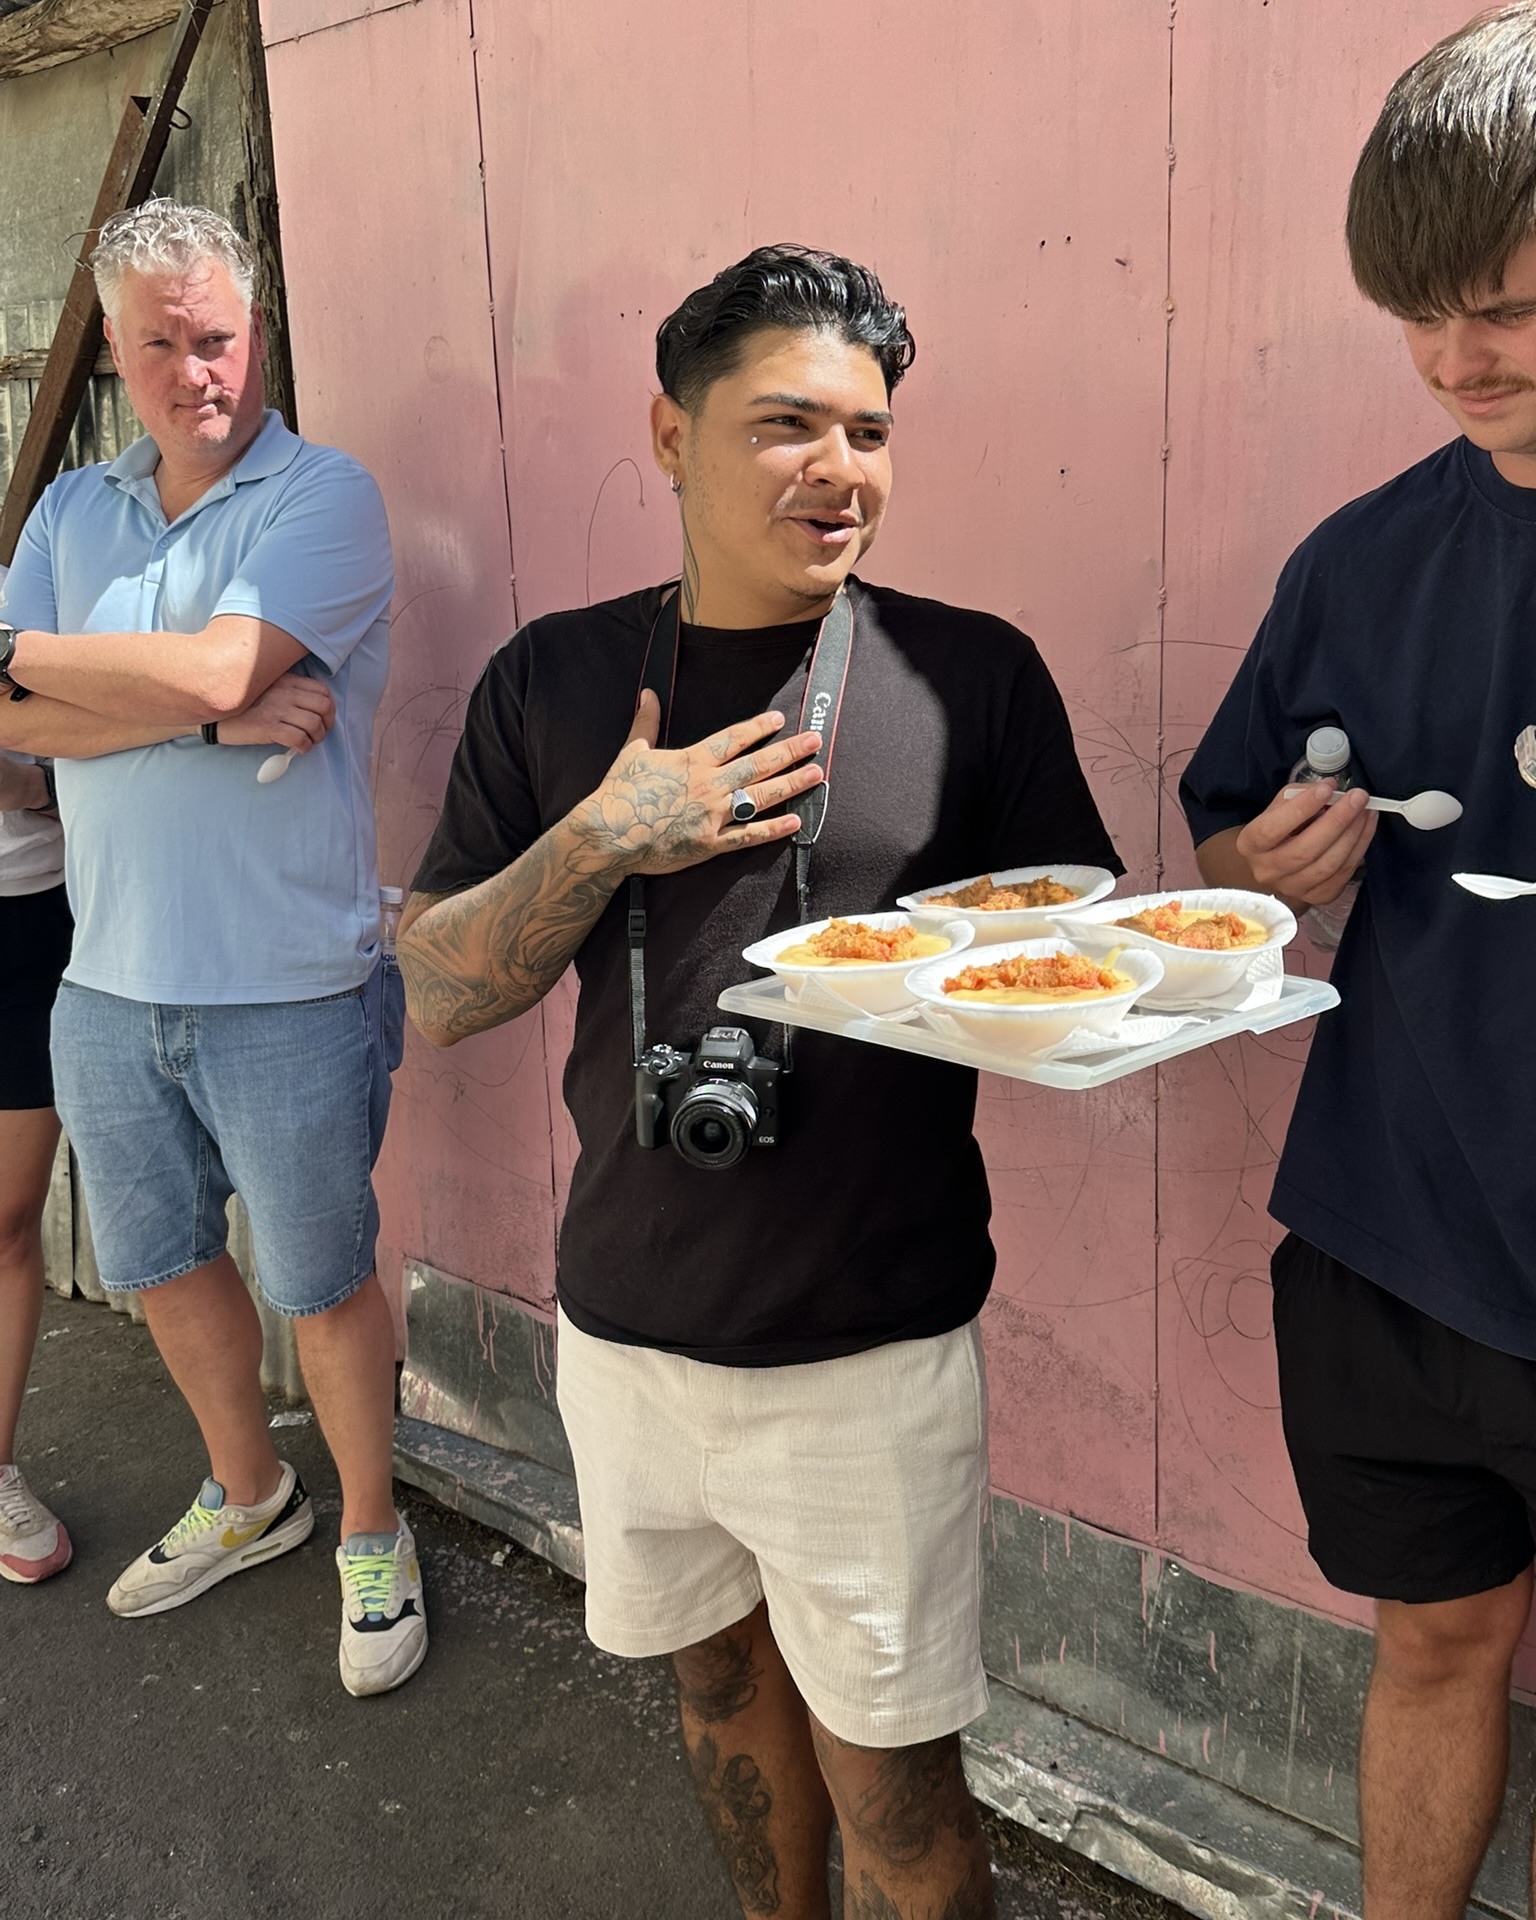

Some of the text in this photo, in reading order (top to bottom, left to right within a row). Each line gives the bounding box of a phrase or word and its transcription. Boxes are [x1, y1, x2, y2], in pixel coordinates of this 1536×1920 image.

[810, 692, 831, 738] Can
[703, 1060, 734, 1069] Canon
[759, 1136, 775, 1144] EOS
